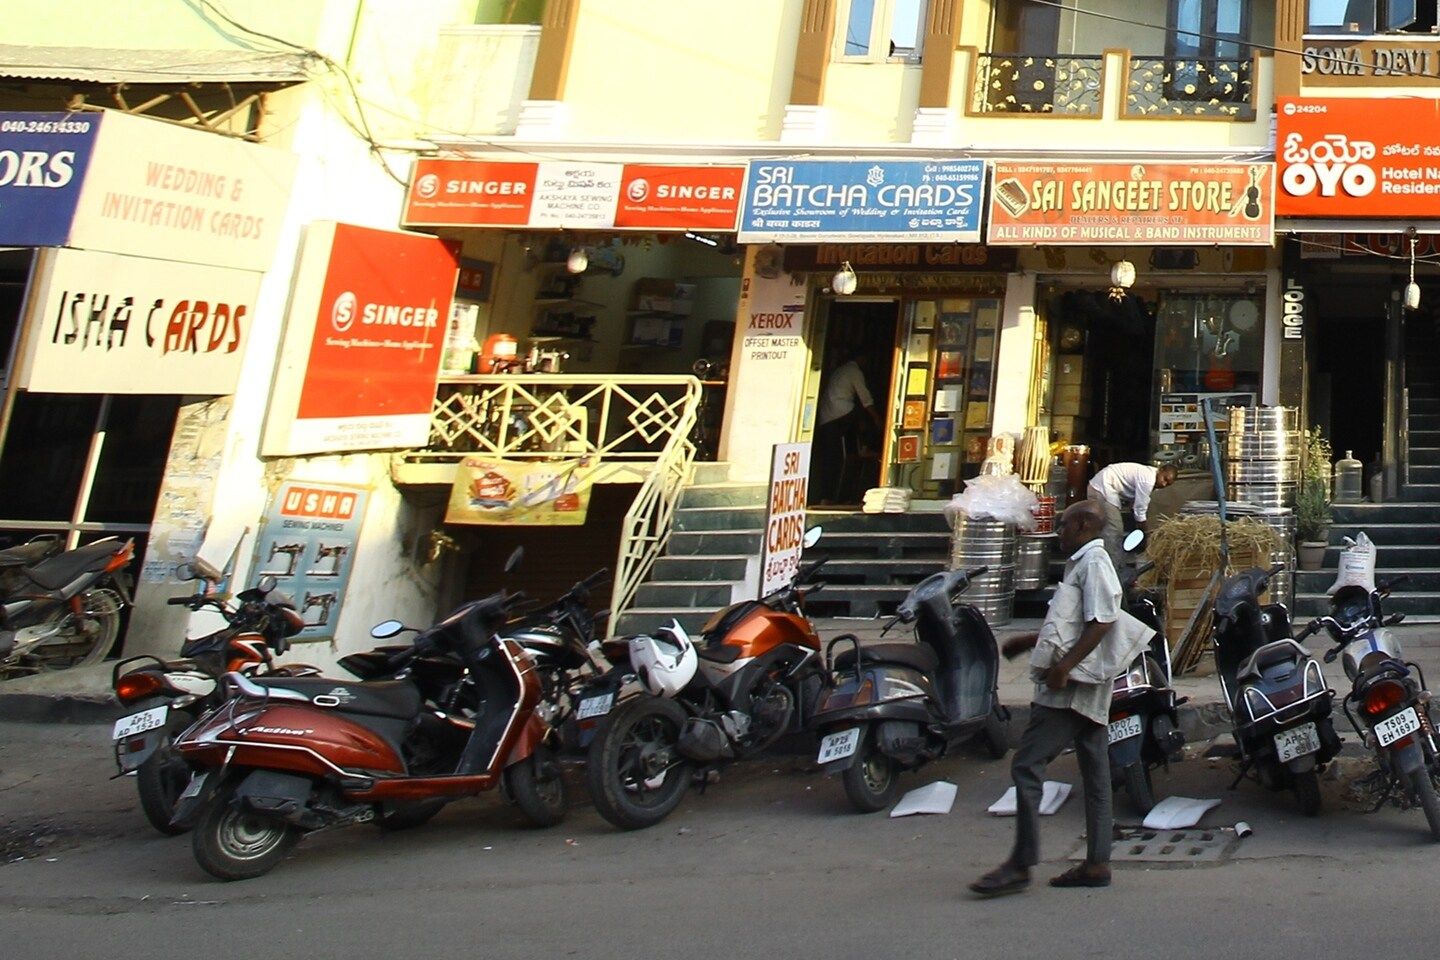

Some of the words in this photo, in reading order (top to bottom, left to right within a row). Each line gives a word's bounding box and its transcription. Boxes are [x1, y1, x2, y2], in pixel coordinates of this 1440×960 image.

[1301, 47, 1364, 75] SONA
[1372, 48, 1430, 76] DEVI
[1296, 105, 1327, 113] 24204
[146, 162, 226, 198] WEDDING
[230, 178, 243, 201] &
[756, 166, 794, 185] SRI
[1282, 162, 1376, 197] OYO
[1382, 167, 1422, 180] Hotel
[446, 180, 527, 195] SINGER
[656, 184, 735, 200] SINGER
[753, 184, 867, 207] BATCHA
[877, 184, 974, 207] CARDS
[1031, 179, 1064, 214] SAI
[1071, 179, 1163, 214] SANGEET
[1168, 180, 1233, 214] STORE
[101, 192, 205, 231] INVITATION
[211, 210, 264, 240] CARDS
[752, 208, 791, 216] Exclusive
[793, 207, 836, 216] Showroom
[839, 208, 850, 217] of
[851, 207, 887, 217] Wedding
[903, 208, 943, 216] Invitation
[946, 207, 970, 216] Cards
[1070, 215, 1109, 224] DEALERS
[997, 227, 1019, 239] ALL
[1022, 227, 1058, 239] KINDS
[1061, 227, 1077, 239] OF
[1081, 227, 1130, 239] MUSICAL
[1134, 227, 1143, 239] &
[1146, 227, 1180, 239] BAND
[1183, 227, 1261, 239] INSTRUMENTS
[816, 243, 920, 265] Invitation
[362, 303, 439, 328] SINGER
[1282, 279, 1304, 340] LODGE
[51, 290, 133, 352] ISHA
[145, 299, 247, 356] CARDS
[749, 313, 794, 329] XEROX
[744, 338, 770, 348] OFFSET
[772, 338, 800, 347] MASTER
[751, 351, 787, 360] PRINTOUT
[784, 452, 800, 474] SRI
[285, 491, 354, 515] USHA
[772, 477, 806, 515] BATCHA
[768, 514, 803, 553] CARDS
[1110, 717, 1132, 733] AP07
[1382, 730, 1395, 744] EH
[1395, 720, 1415, 736] 1697
[1384, 713, 1406, 731] TS09
